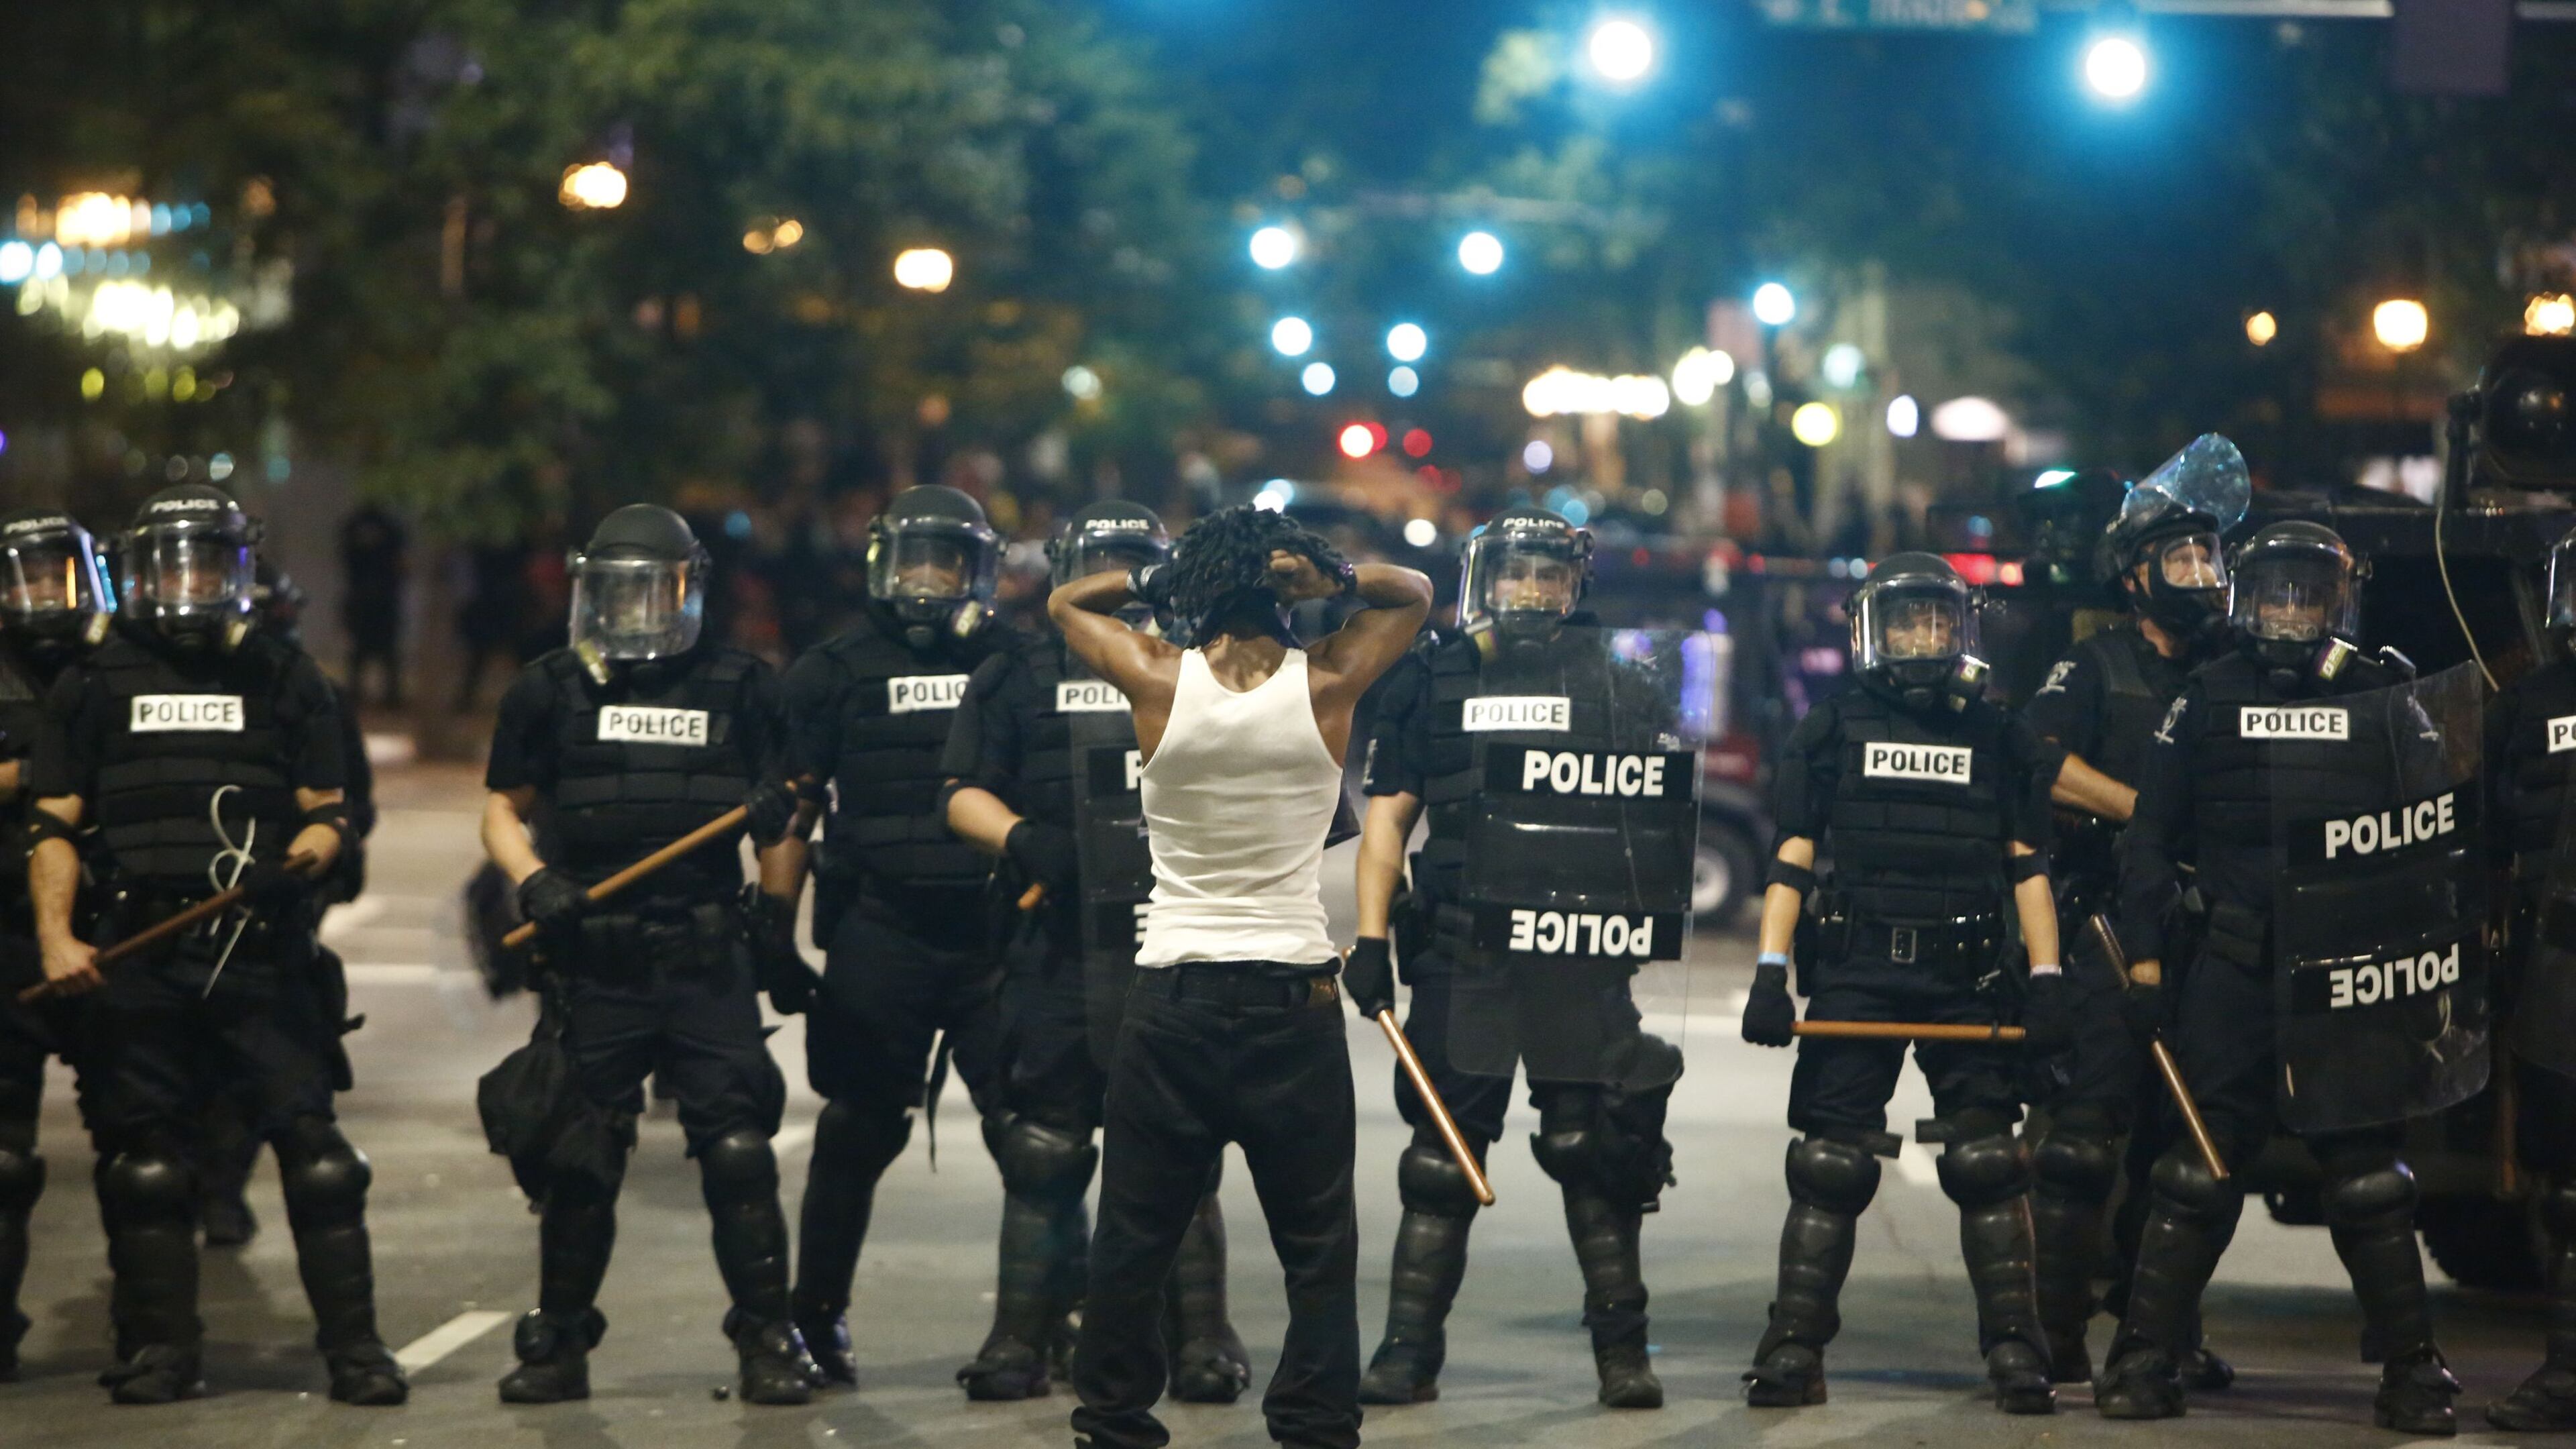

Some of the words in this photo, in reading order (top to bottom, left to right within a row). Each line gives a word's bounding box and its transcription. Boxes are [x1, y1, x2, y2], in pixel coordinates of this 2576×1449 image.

[1085, 519, 1150, 529] POLICE
[897, 682, 967, 703] POLIC
[1065, 686, 1122, 704] POLI
[140, 702, 235, 722] POLICE
[1472, 704, 1563, 723] POLICE
[2247, 712, 2341, 733] POLICE
[610, 712, 702, 737] POLICE
[1523, 750, 1665, 796] POLICE
[1873, 749, 1965, 775] POLICE
[2325, 792, 2455, 859] POLICE
[1509, 910, 1653, 955] POLICE
[2330, 943, 2459, 1008] POLICE
